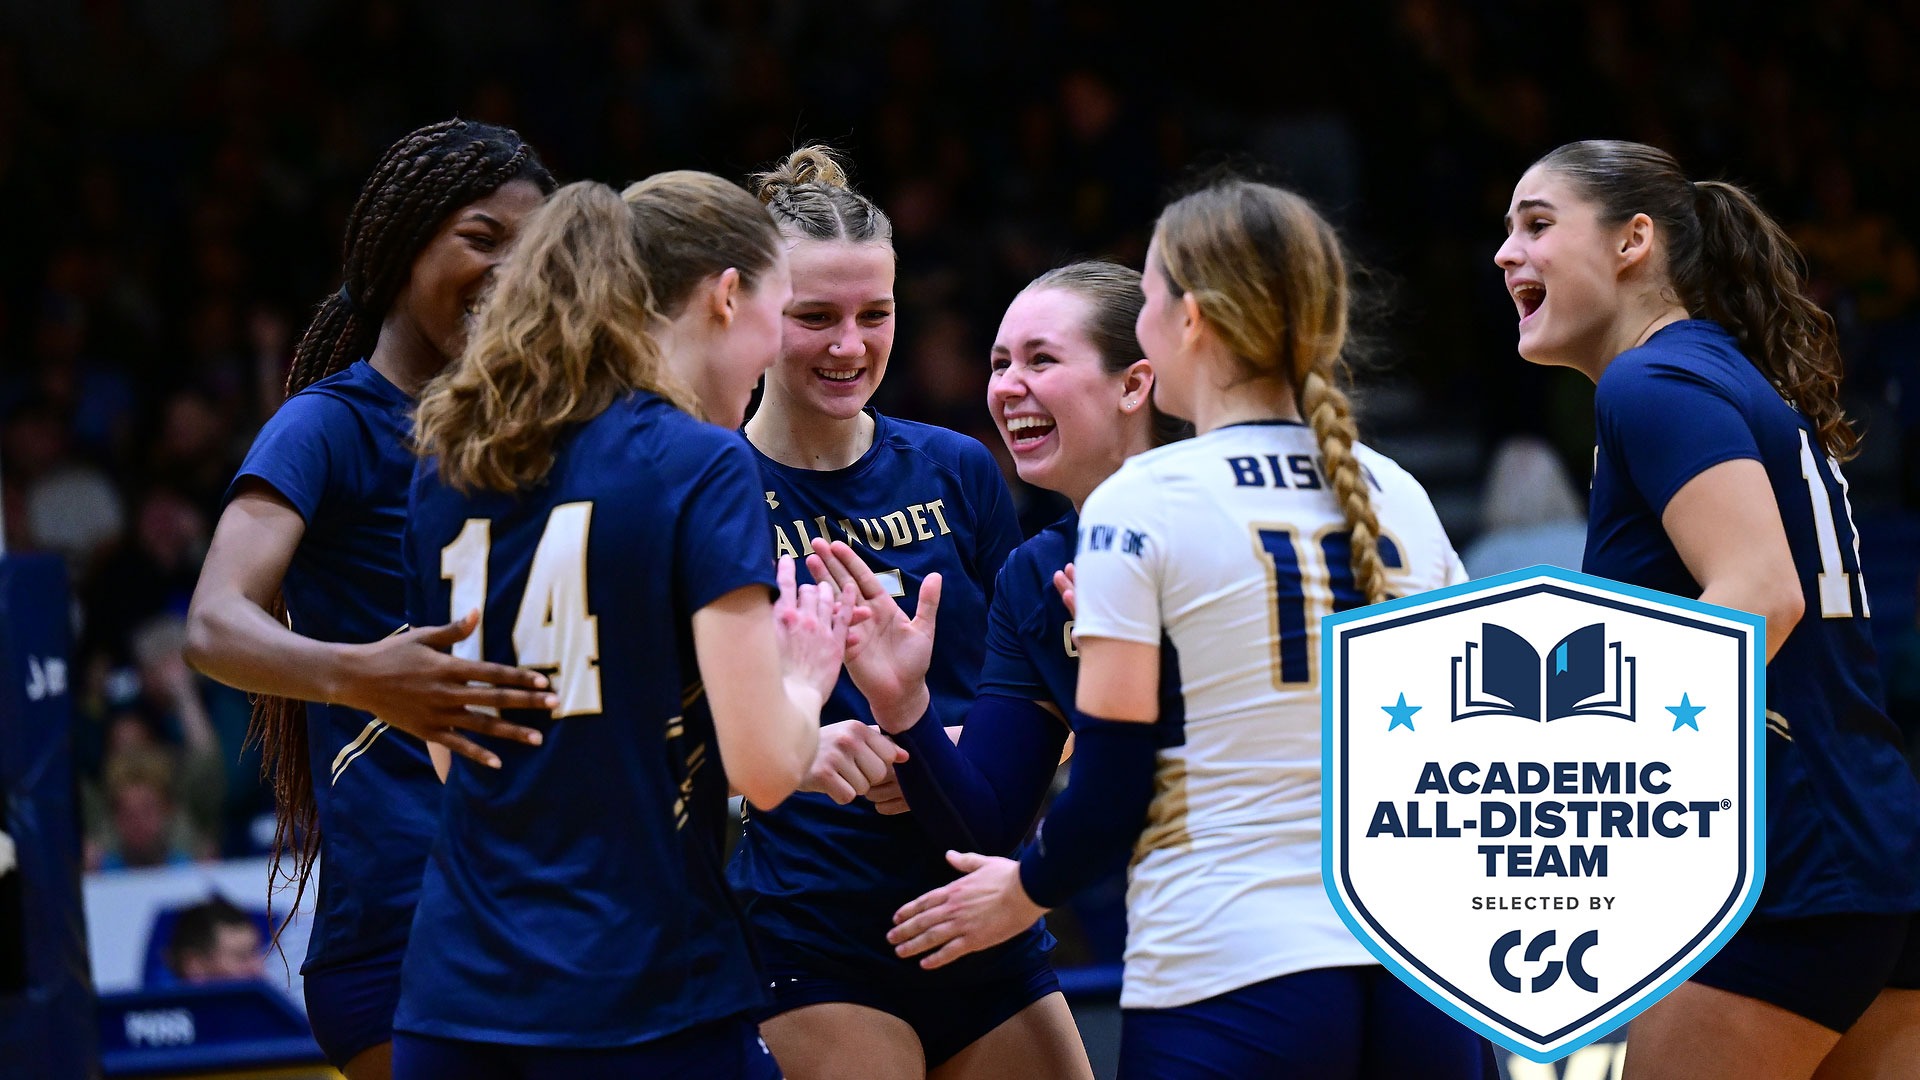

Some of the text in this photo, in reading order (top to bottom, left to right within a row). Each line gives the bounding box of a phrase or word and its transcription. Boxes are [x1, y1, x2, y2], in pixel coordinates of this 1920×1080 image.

[1226, 454, 1383, 493] BIS
[774, 499, 952, 559] ALLAUDET
[441, 501, 603, 721] 14
